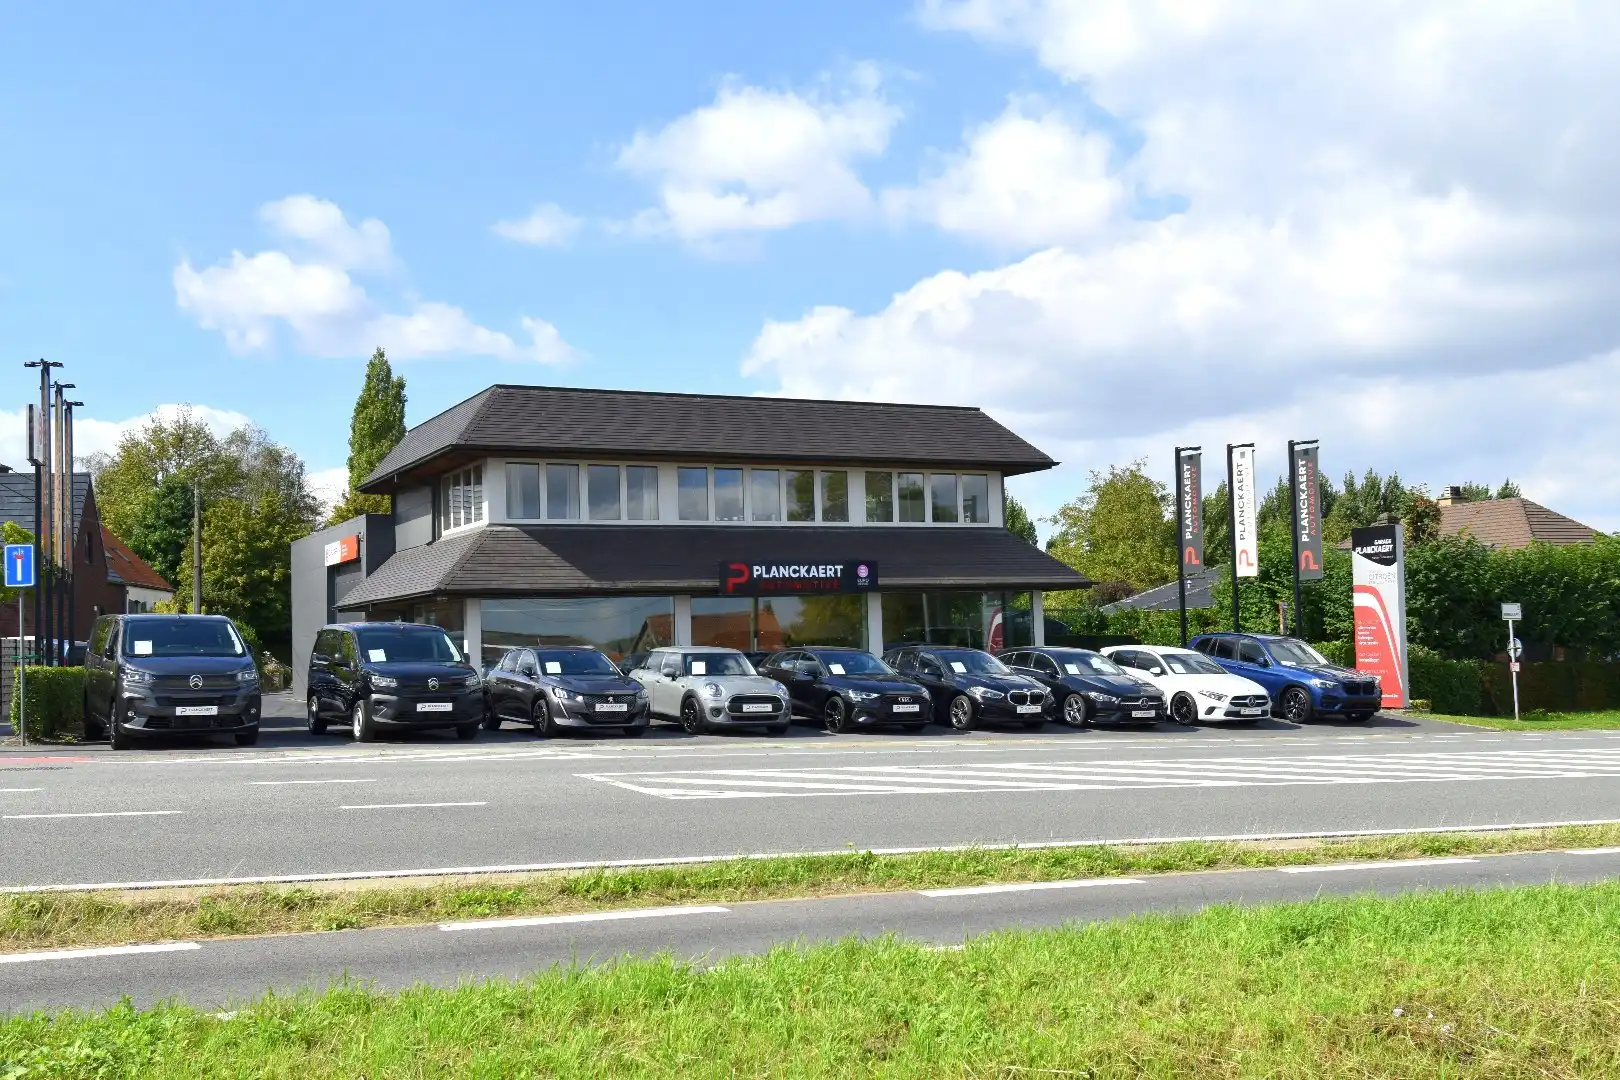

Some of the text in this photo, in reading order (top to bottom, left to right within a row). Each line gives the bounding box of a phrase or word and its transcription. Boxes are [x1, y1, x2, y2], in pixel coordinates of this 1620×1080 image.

[1183, 463, 1193, 540] PLANCKAERT
[1190, 466, 1199, 534] AUTOMOTIVE
[1236, 462, 1246, 541] PLANCKAERT
[1299, 459, 1310, 542] PLANCKAERT
[1308, 461, 1317, 536] AUTOMOTIVE
[752, 565, 844, 578] PLANCKAERT
[1355, 544, 1394, 554] PLANCKAERT
